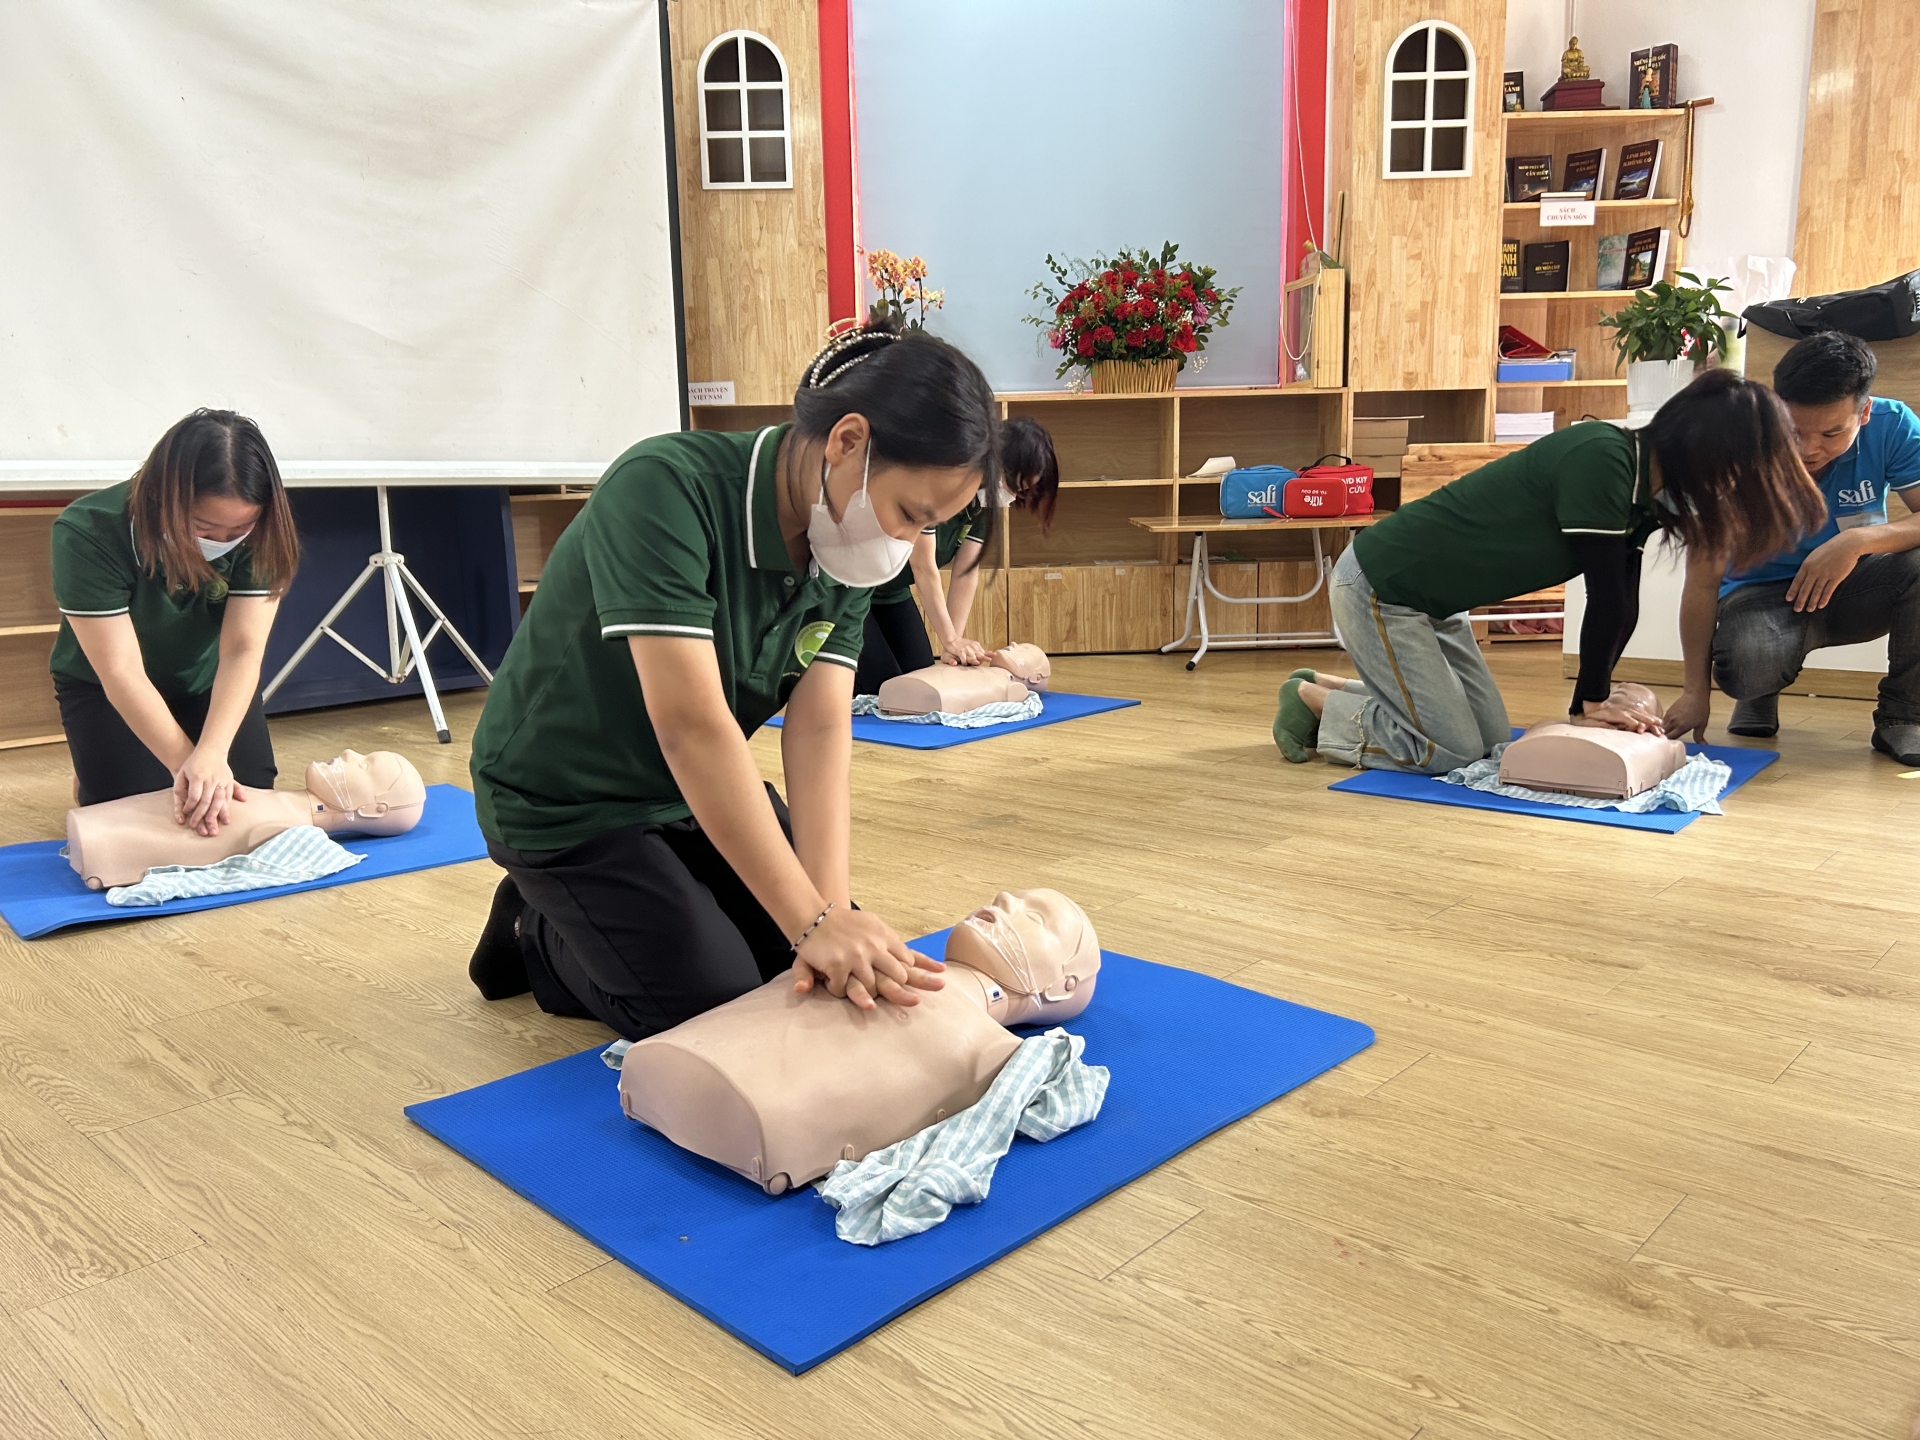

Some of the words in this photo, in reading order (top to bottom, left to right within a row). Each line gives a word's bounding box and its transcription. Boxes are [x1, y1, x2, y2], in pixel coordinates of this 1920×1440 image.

[1248, 484, 1276, 504] safi
[1348, 485, 1366, 494] CỨU
[1838, 480, 1876, 504] safi
